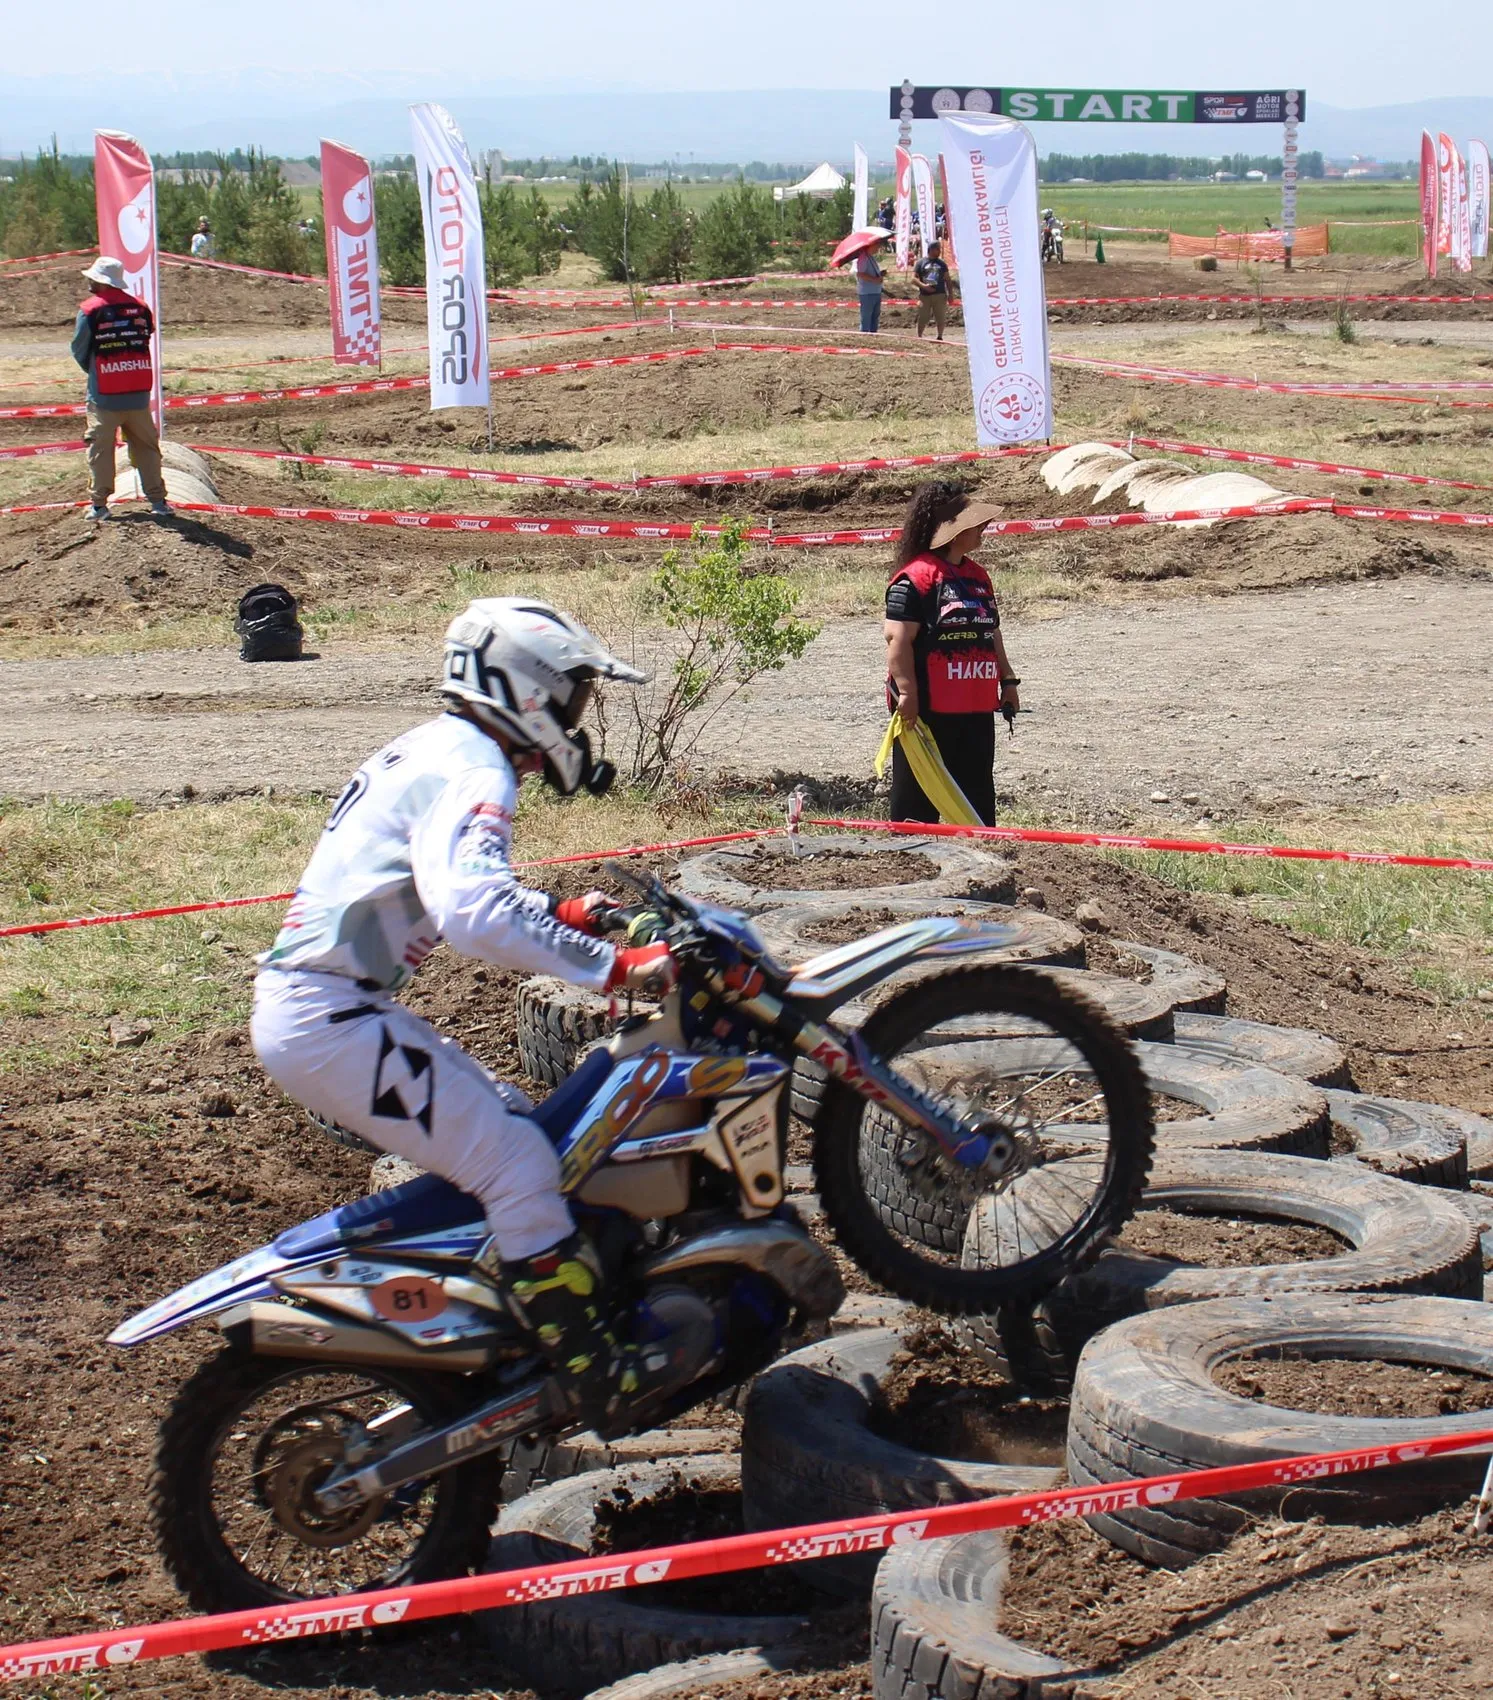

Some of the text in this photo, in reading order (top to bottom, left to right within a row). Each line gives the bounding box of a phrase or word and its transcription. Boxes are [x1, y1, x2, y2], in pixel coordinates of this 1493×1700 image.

[1009, 92, 1188, 119] START
[1256, 94, 1280, 103] AĞRI
[392, 1288, 428, 1311] 81
[1325, 1453, 1388, 1475] TMF
[1071, 1493, 1134, 1516] TMF
[814, 1533, 880, 1556] TMF
[555, 1573, 622, 1597] TMF
[294, 1613, 360, 1636] TMF
[28, 1654, 92, 1677] TMF
